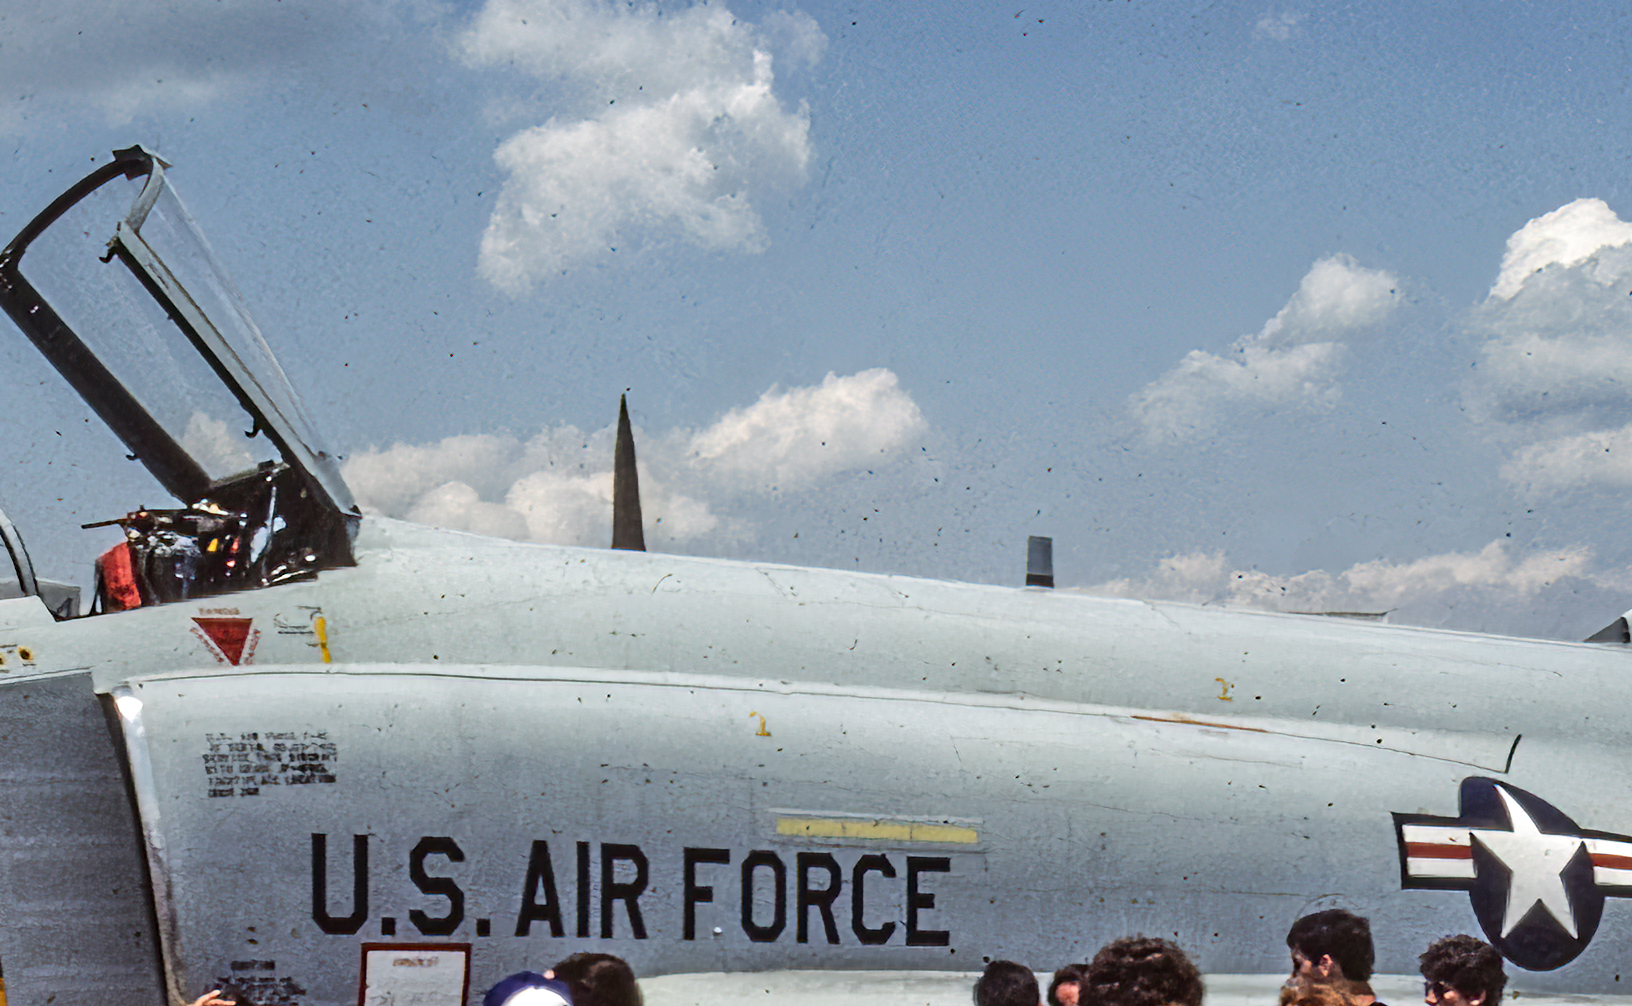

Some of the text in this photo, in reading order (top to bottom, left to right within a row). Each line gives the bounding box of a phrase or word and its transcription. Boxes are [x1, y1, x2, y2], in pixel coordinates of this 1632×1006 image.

[311, 832, 951, 948] U.S. AIR FORCE
